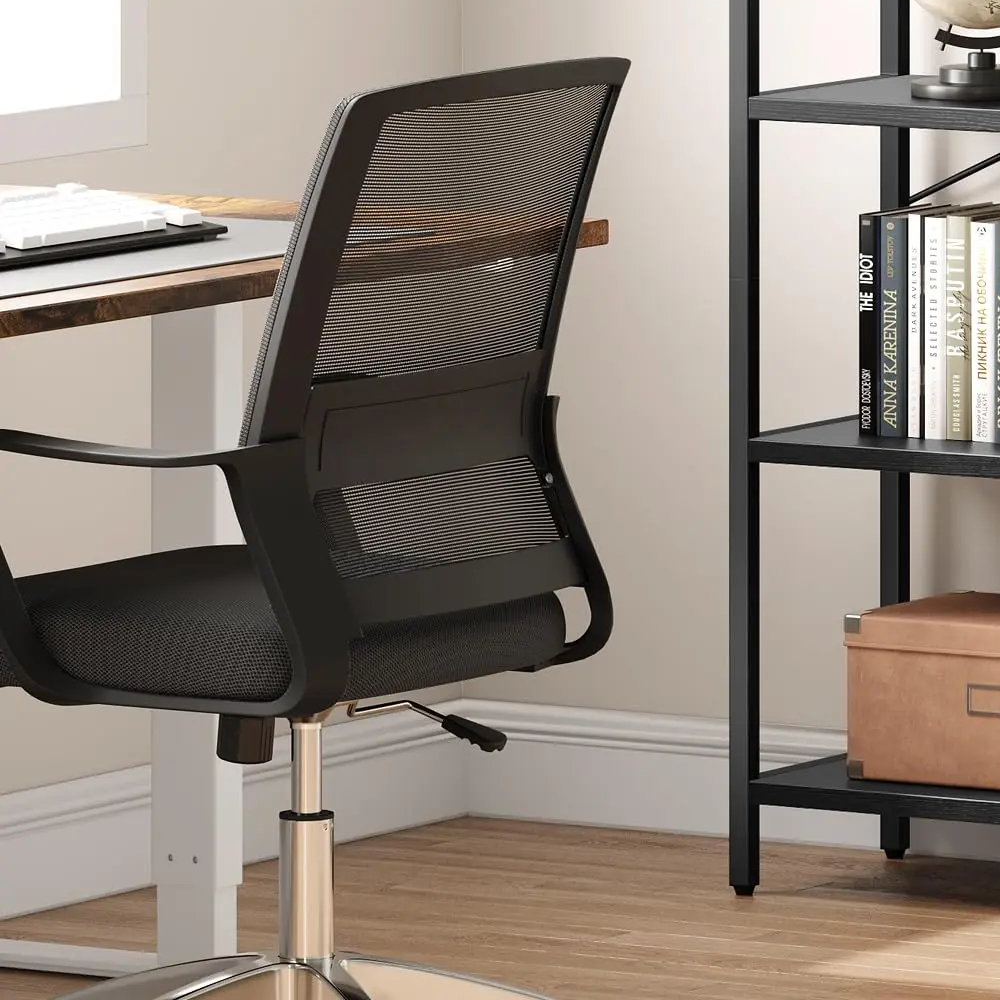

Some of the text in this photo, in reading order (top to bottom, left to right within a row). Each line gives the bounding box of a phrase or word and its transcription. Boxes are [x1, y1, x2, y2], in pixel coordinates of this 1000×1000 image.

[859, 253, 874, 312] THE IDIOT
[929, 238, 938, 357] SELECTED STORIES
[945, 237, 965, 357] RASPUTIN
[977, 308, 987, 324] НА
[883, 289, 897, 428] ANNA KARENINA
[977, 328, 988, 380] ПИКНИК
[952, 374, 961, 398] SMITH
[861, 406, 871, 429] FYODOR
